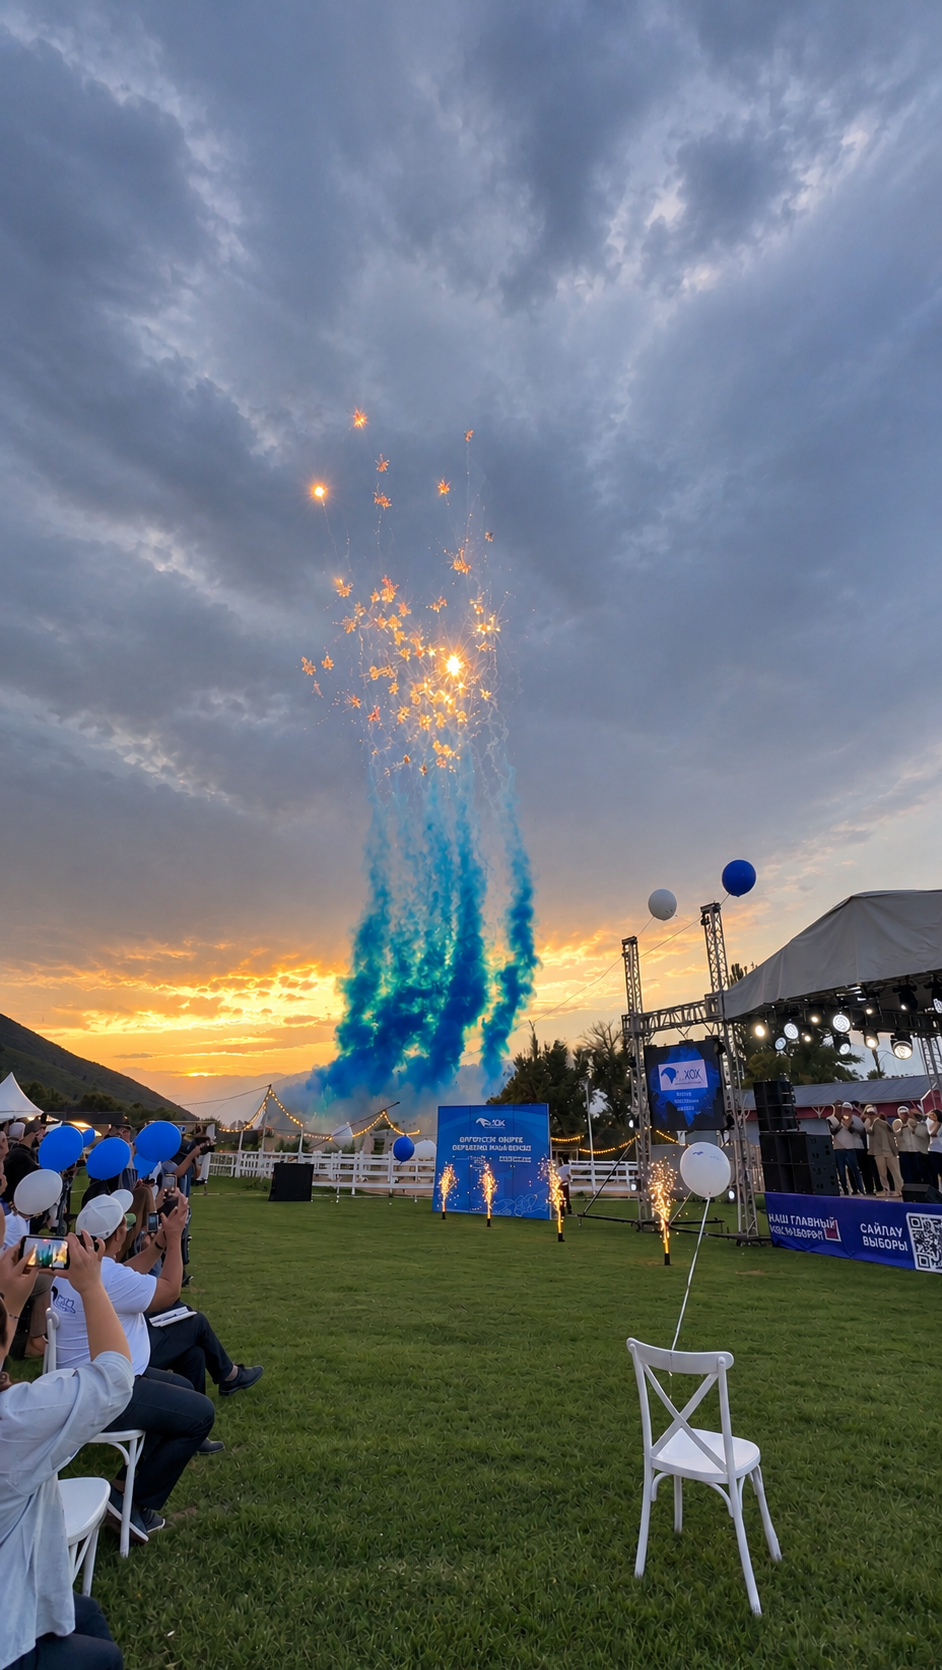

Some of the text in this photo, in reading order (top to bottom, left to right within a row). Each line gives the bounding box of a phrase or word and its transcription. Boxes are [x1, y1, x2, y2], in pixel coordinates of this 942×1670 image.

[768, 1213, 835, 1229] НАШ ГЛАВНЫЙ
[859, 1221, 903, 1238] САЙЛАУ
[862, 1235, 909, 1251] ВЫБОРЫ
